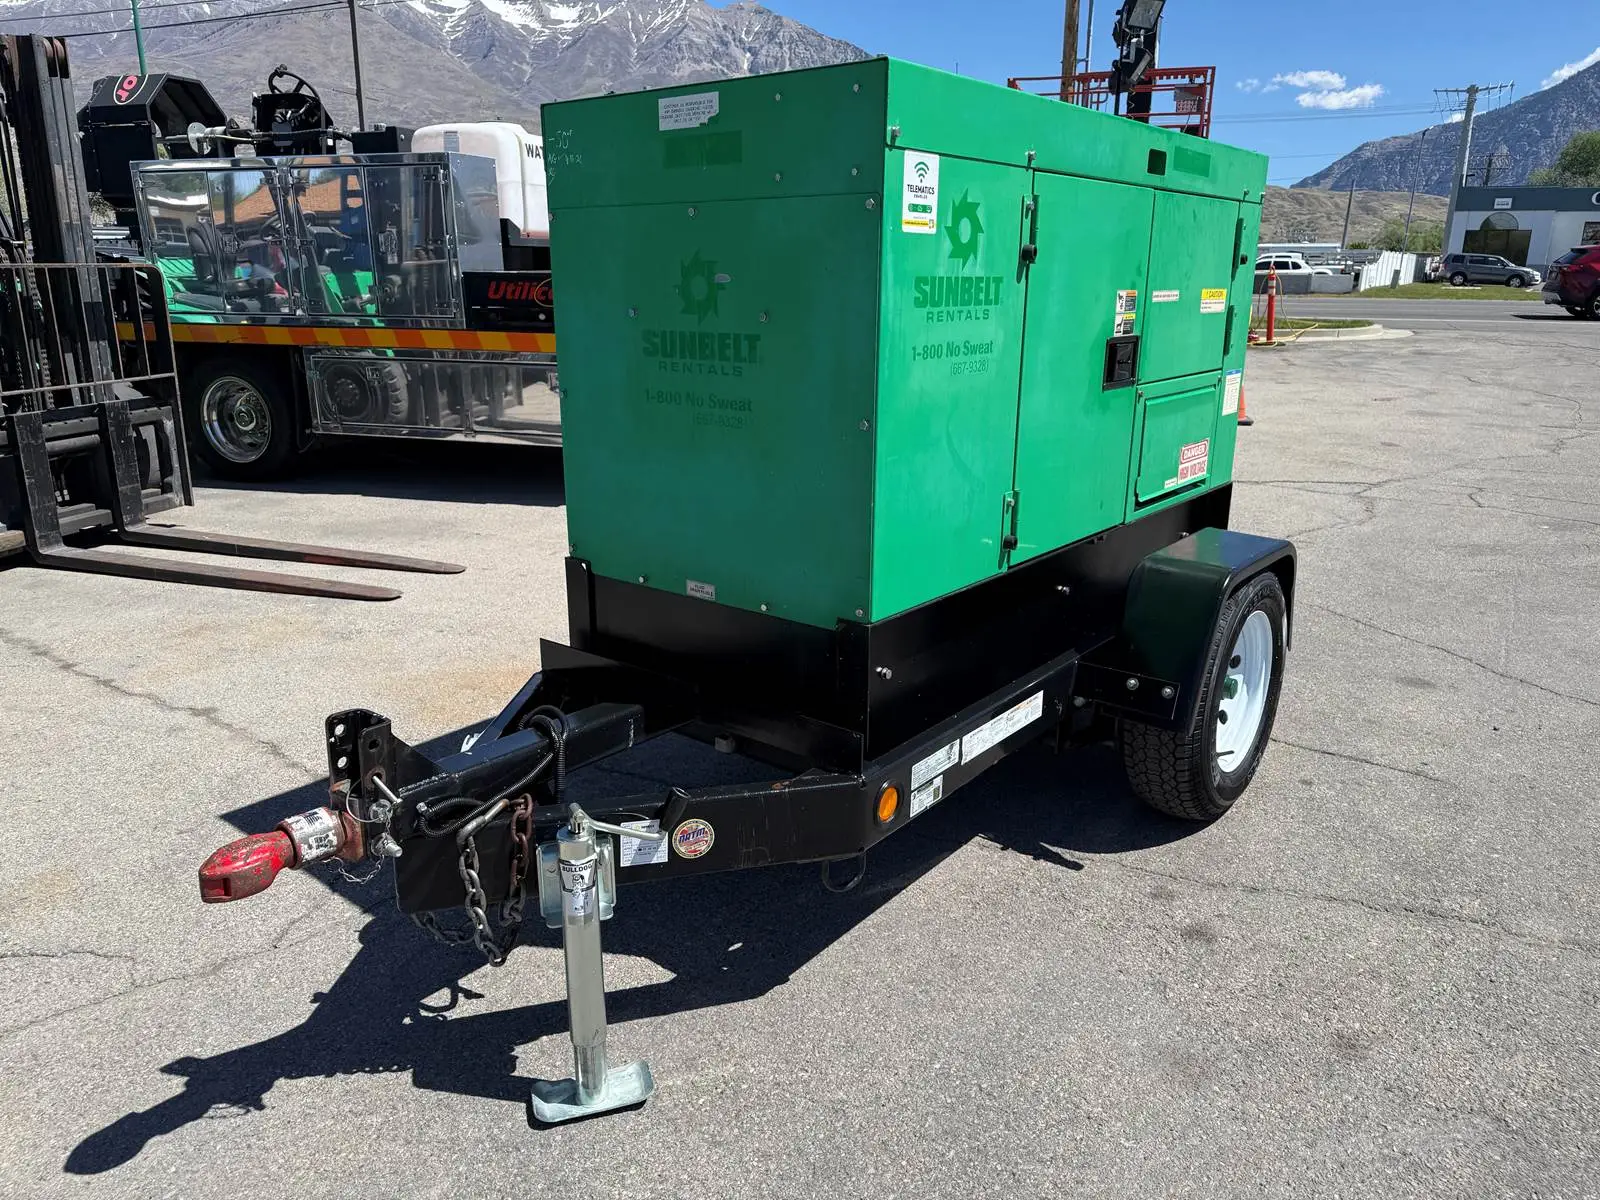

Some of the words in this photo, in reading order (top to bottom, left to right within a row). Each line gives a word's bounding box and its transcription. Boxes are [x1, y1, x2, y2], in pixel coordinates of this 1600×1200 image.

[907, 184, 935, 195] TELEMATICS
[914, 276, 1004, 309] SUNBELT
[926, 309, 990, 323] RENTALS
[642, 329, 761, 364] SUNBELT
[912, 343, 943, 361] 1-800
[946, 340, 960, 358] No
[962, 340, 993, 356] Sweat
[658, 360, 744, 377] RENTALS
[950, 359, 989, 376] (667-9328)
[645, 388, 682, 406] 1-800
[686, 391, 704, 408] No
[709, 393, 753, 412] Sweat
[1183, 444, 1206, 460] DANGER
[1189, 459, 1206, 477] VOLTAGE
[562, 863, 593, 873] BULLDOG
